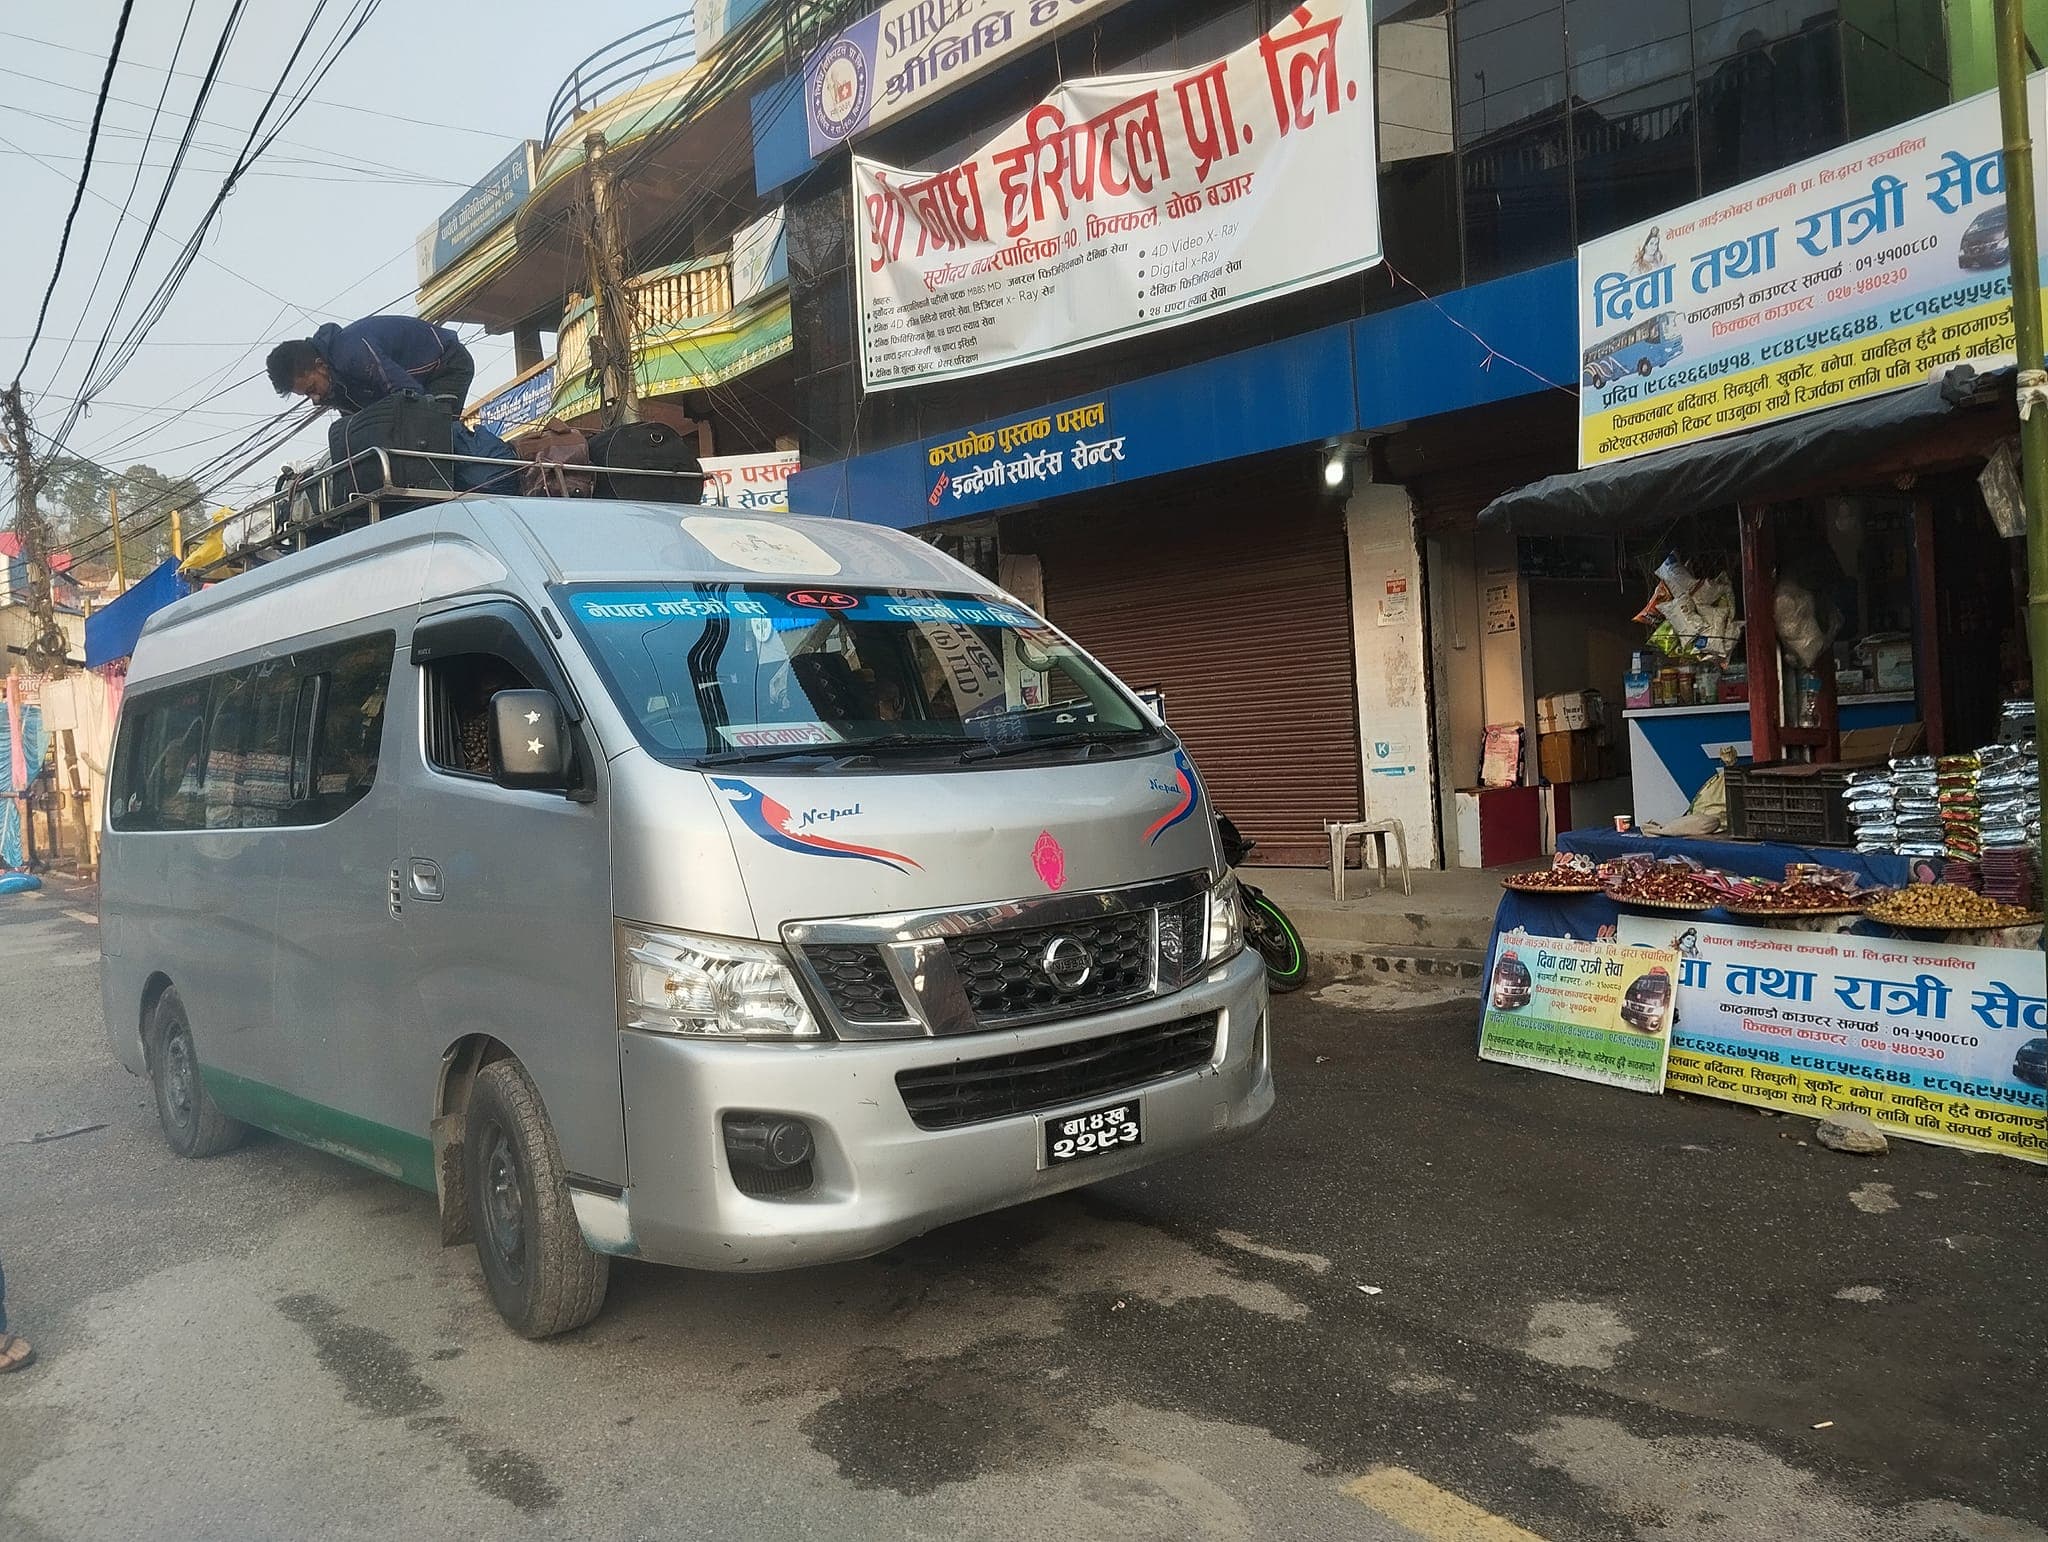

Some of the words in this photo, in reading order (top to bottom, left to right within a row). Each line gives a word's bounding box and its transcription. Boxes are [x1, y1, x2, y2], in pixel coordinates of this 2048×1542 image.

[1174, 60, 1254, 184] प्रा.
[1165, 191, 1203, 220] चोक
[1205, 172, 1255, 206] बजार
[1151, 244, 1168, 257] 4D
[1171, 235, 1203, 253] Video
[1221, 222, 1239, 238] Ray
[1666, 221, 1695, 241] नेपाल
[1594, 263, 1678, 328] दिवा
[1690, 227, 1779, 294] तथा
[1795, 174, 1909, 258] रात्री
[1149, 284, 1177, 298] दैनिक
[1225, 259, 1242, 275] सेवा
[1150, 257, 1188, 279] Digital
[987, 280, 1002, 293] MD
[1019, 289, 1039, 303] Ray
[1210, 286, 1227, 301] सेवा
[1687, 293, 1745, 325] काठमाण्डौ
[1748, 279, 1799, 307] काउण्टर
[1801, 266, 1843, 295] सम्पर्क
[1712, 312, 1760, 338] फिक्कल
[1763, 298, 1815, 327] काउण्टर
[1601, 381, 1638, 409] प्रदिप
[1681, 408, 1713, 433] टिकट
[1765, 387, 1791, 413] साथै
[1849, 366, 1881, 393] लागि
[1885, 359, 1911, 384] पनि
[1611, 402, 1674, 433] फिक्कलबाट
[928, 430, 996, 467] करफोक
[997, 415, 1051, 453] पुस्तक
[1056, 402, 1105, 433] पसल
[951, 459, 1005, 500] इन्द्रेणी
[1070, 437, 1127, 470] सेन्टर
[737, 488, 789, 509] सेन्ट
[583, 601, 653, 619] नेपाल
[731, 600, 769, 616] बस
[796, 593, 851, 605] A/C
[883, 603, 958, 620] कम्पनी
[1149, 778, 1182, 794] Nepal
[798, 803, 864, 829] Nepal
[1702, 935, 1733, 947] नेपाल
[1536, 949, 1557, 969] दिवा
[1558, 955, 1578, 971] तथा
[1579, 954, 1602, 975] रात्री
[1604, 958, 1625, 977] सेवा
[1678, 958, 1712, 989] वा
[1726, 963, 1818, 1003] तथा
[1834, 973, 1953, 1020] रात्री
[1719, 1002, 1779, 1021] काठमाण्डौ
[1782, 1011, 1832, 1029] काउण्टर
[1836, 1016, 1880, 1035] सम्पर्क
[1742, 1018, 1793, 1038] फिक्कल
[1796, 1028, 1847, 1047] काउण्टर
[1707, 1075, 1738, 1092] टिकट
[1791, 1087, 1817, 1107] साथै
[1876, 1105, 1910, 1125] लागि
[1915, 1114, 1940, 1130] पनि
[1923, 1076, 2047, 1109] ९८१६९५५५६
[1053, 1121, 1139, 1158] २२९३
